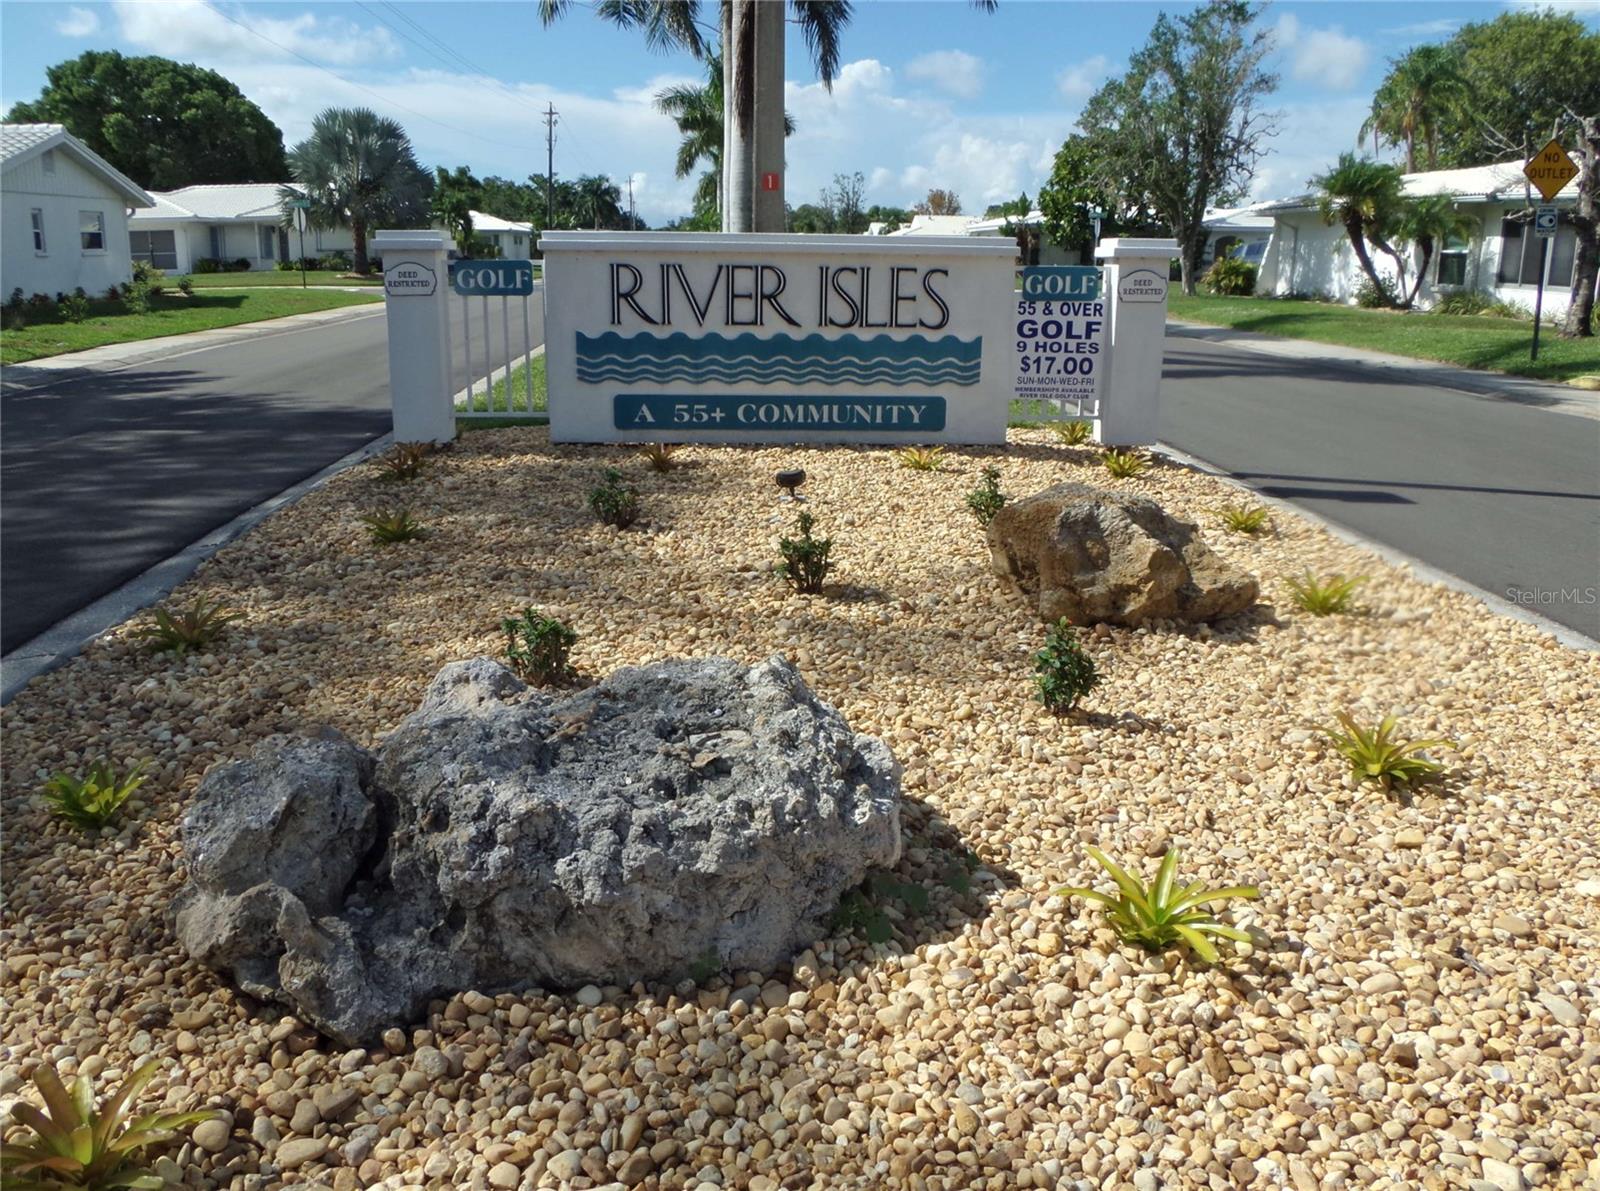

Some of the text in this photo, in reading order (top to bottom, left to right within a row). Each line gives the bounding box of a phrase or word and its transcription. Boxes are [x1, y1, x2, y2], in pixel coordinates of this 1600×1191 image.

[1544, 152, 1560, 163] NO
[1530, 168, 1574, 179] OUTLET
[388, 280, 430, 288] RESTRICTED
[456, 268, 531, 289] GOLF
[1025, 274, 1098, 295] GOLF
[1133, 279, 1153, 287] DEED
[609, 263, 951, 331] RIVER ISLES
[1017, 301, 1103, 317] 55 & OVER
[1016, 319, 1102, 340] GOLF
[1016, 341, 1100, 354] 9 HOLES
[1020, 355, 1093, 375] $17.00
[1017, 376, 1095, 386] SUN-MON-WED-FRI
[634, 403, 927, 424] A 55+ COMMUNITY
